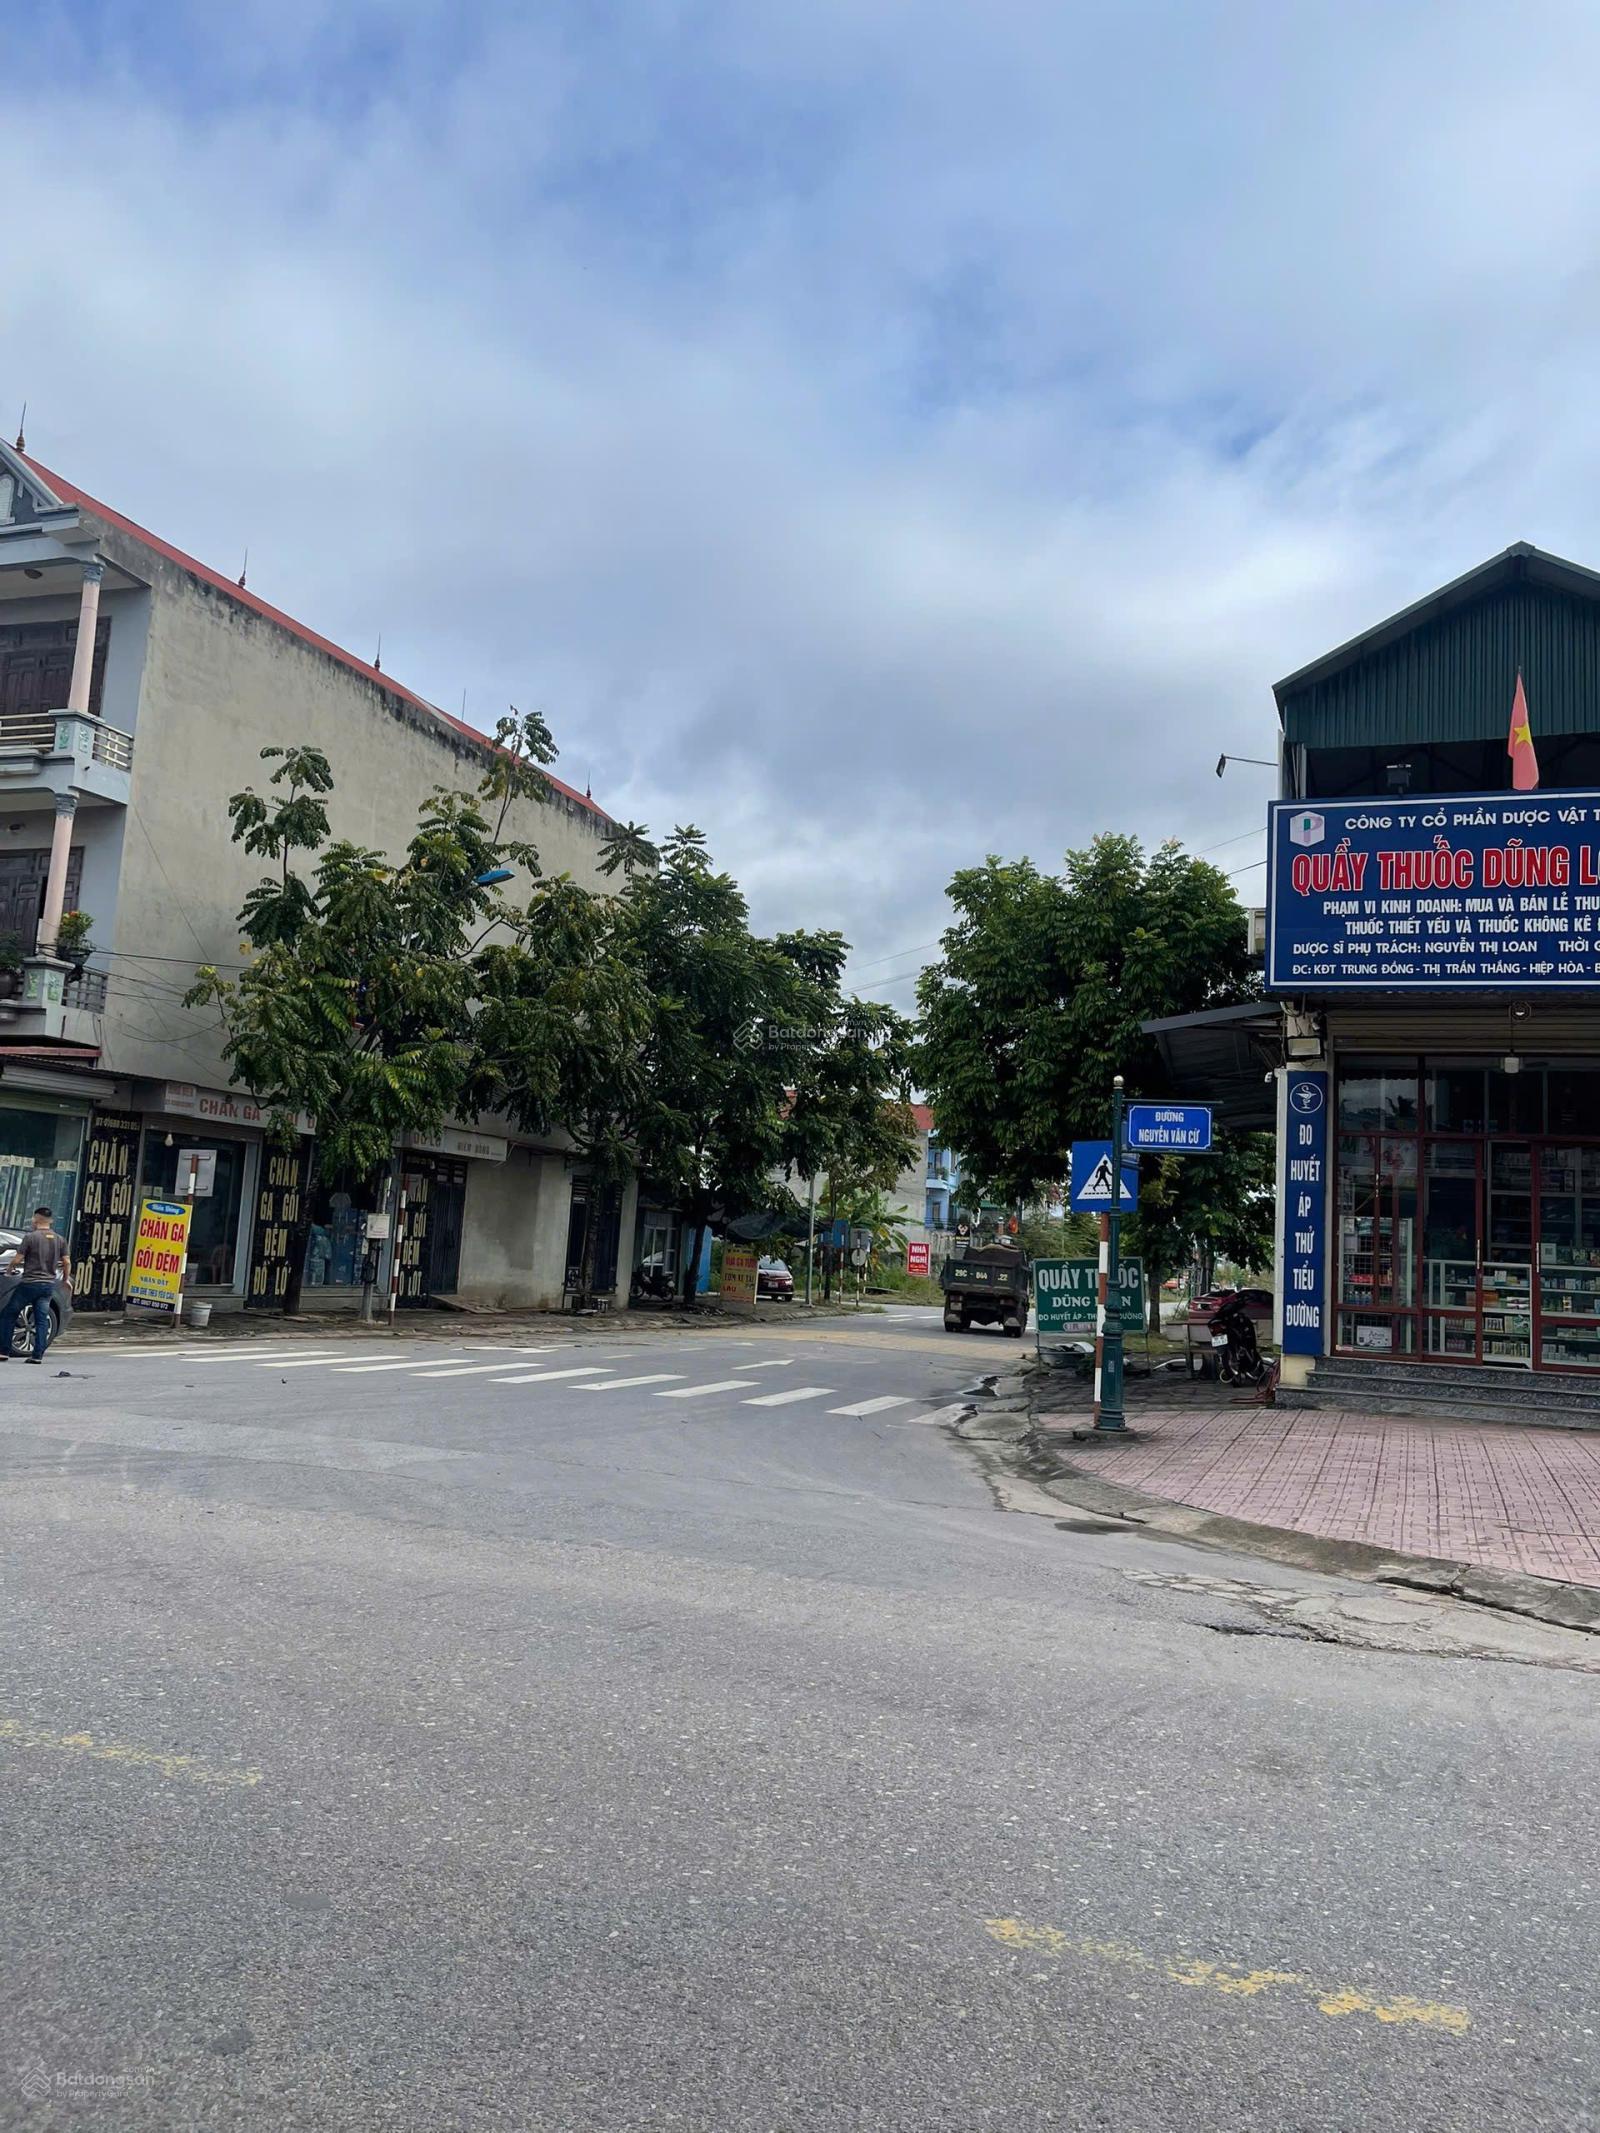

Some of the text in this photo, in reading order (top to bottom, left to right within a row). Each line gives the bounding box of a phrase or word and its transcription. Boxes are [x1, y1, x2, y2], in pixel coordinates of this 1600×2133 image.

[1345, 814, 1392, 830] CÔNG
[1398, 815, 1416, 828] TY
[1422, 807, 1447, 827] CỔ
[1453, 807, 1497, 826] PHẦN
[1502, 809, 1550, 827] DƯỢC
[1558, 806, 1587, 825] VẬT
[1292, 834, 1600, 896] QUẦY THUỐC DŨNG L
[1323, 900, 1359, 918] PHẠM
[1364, 901, 1376, 914] VI
[1381, 899, 1411, 914] KINH
[1416, 898, 1462, 913] DOANH:
[1465, 898, 1493, 912] MUA
[1498, 894, 1514, 911] VÀ
[1520, 894, 1547, 912] BÁN
[1553, 891, 1568, 911] LẺ
[1345, 916, 1384, 935] THUỐC
[1388, 915, 1421, 934] THIẾT
[1427, 915, 1450, 934] YẾU
[1455, 916, 1472, 934] VÀ
[1478, 914, 1519, 933] THUỐC
[1524, 914, 1568, 932] KHÔNG
[1574, 915, 1591, 932] KÊ
[1293, 936, 1537, 957] DƯỢC SĨ PHỤ TRÁCH: NGUYỄN THỊ LOAN
[1559, 936, 1589, 952] THỜI
[1292, 964, 1311, 975] ĐC:
[1314, 964, 1336, 974] KĐT
[1342, 964, 1377, 974] TRUNG
[1423, 963, 1441, 976] THỊ
[1445, 960, 1476, 974] TRẤN
[1481, 960, 1521, 974] THẮNG
[1530, 961, 1554, 975] HIỆP
[1559, 960, 1584, 974] HÒA
[1155, 1109, 1185, 1122] ĐƯỜNG
[1138, 1125, 1169, 1143] NGUYỄN
[1171, 1127, 1187, 1143] VĂN
[1299, 1124, 1313, 1145] ĐO
[88, 1138, 129, 1175] CHĂN
[1290, 1153, 1321, 1182] HUYẾT
[83, 1174, 133, 1217] GA GỐI
[260, 1186, 299, 1223] GA GỐI
[1298, 1191, 1312, 1217] ÁP
[91, 1216, 123, 1259] ĐỆM
[140, 1216, 185, 1243] CHĂN GA
[264, 1222, 288, 1261] ĐỆM
[1295, 1225, 1315, 1254] THỬ
[136, 1244, 154, 1270] GỐI
[73, 1255, 127, 1296] ĐỒ LÓT
[1038, 1260, 1139, 1292] QUẦY TỐC
[1293, 1260, 1314, 1291] TIỂU
[1052, 1294, 1091, 1308] DŨNG
[1286, 1300, 1320, 1328] ĐƯỜNG
